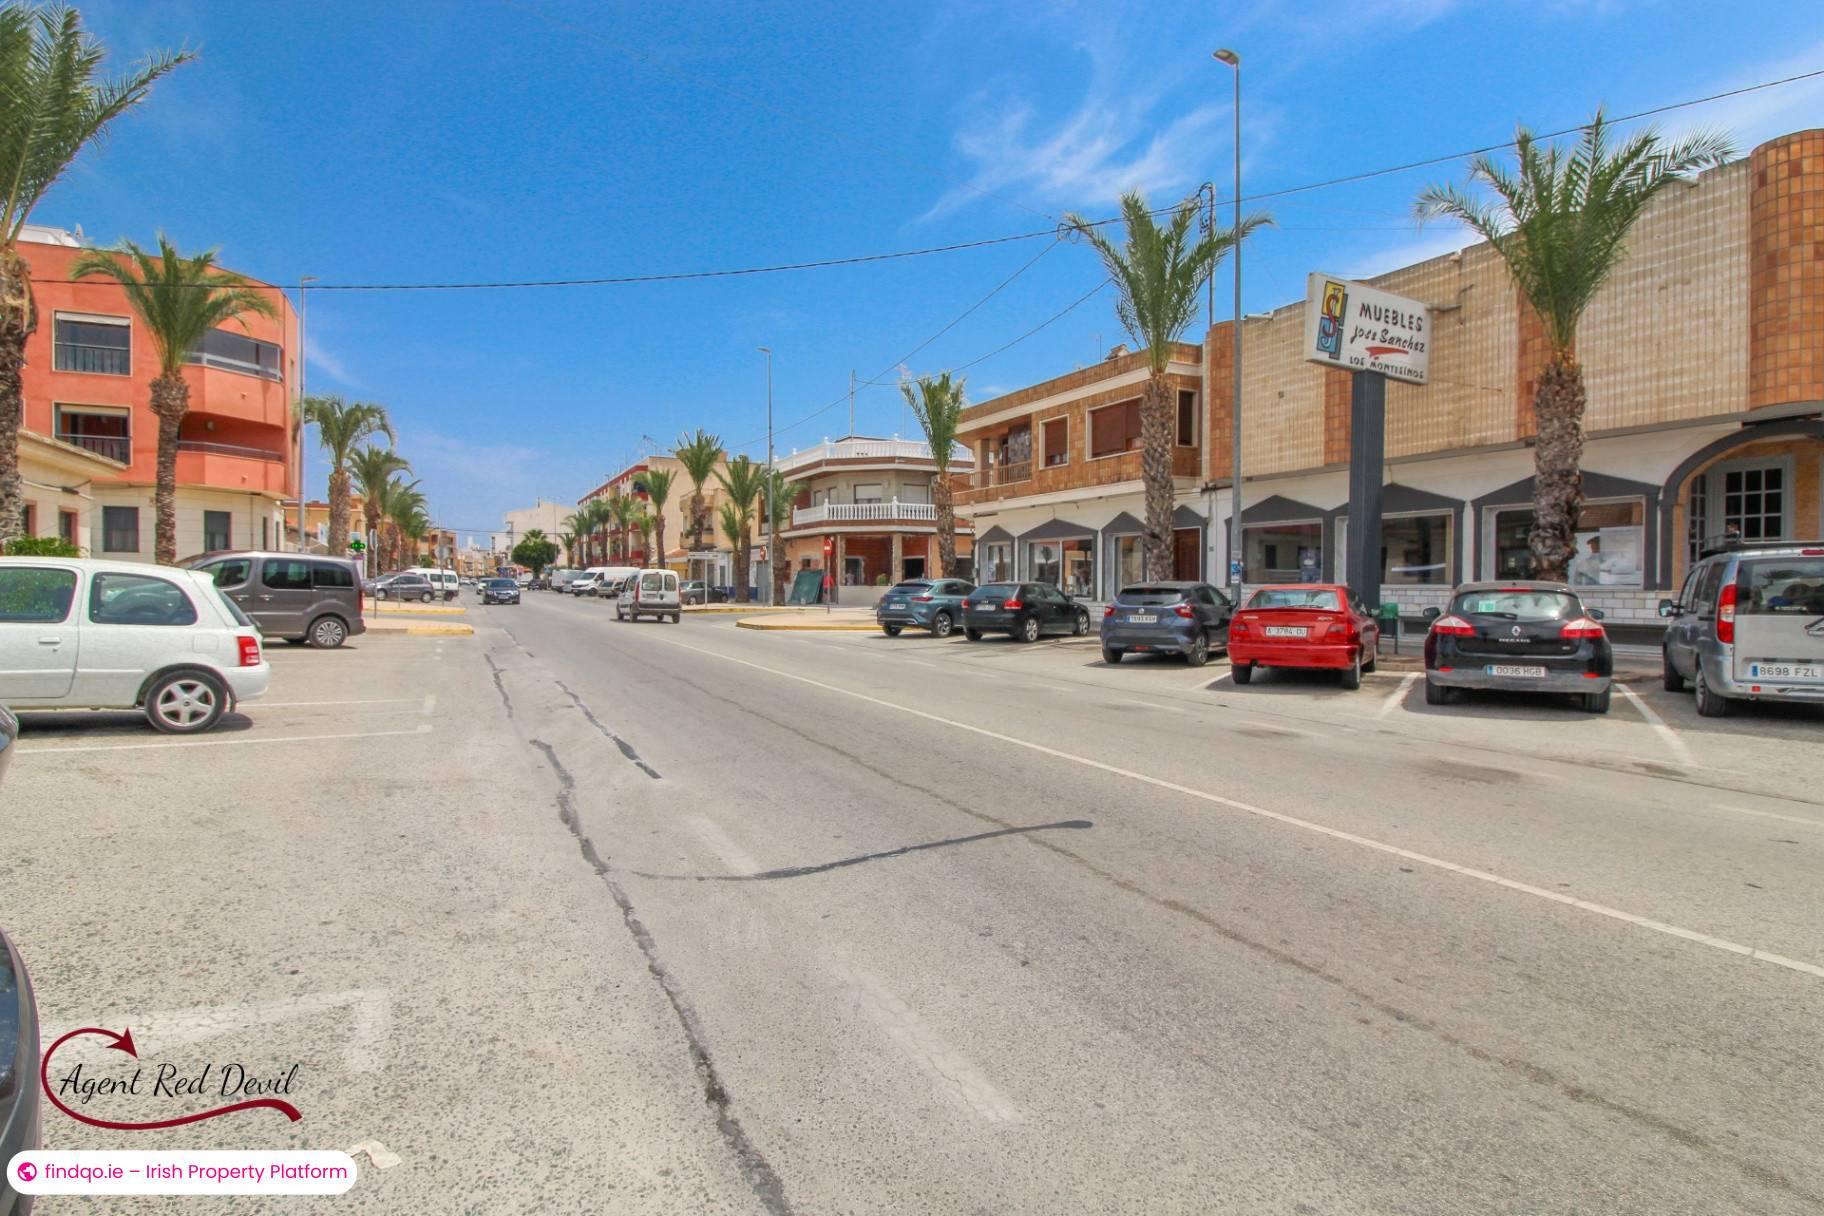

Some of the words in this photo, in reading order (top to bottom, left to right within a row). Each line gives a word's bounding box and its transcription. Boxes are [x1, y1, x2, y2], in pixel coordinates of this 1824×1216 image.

[1359, 302, 1424, 332] MUEBLES
[1379, 328, 1425, 353] Sanchez
[1350, 356, 1365, 366] LOS
[1496, 665, 1521, 675] 0036
[1760, 666, 1789, 676] 8698
[1795, 667, 1818, 678] FZL
